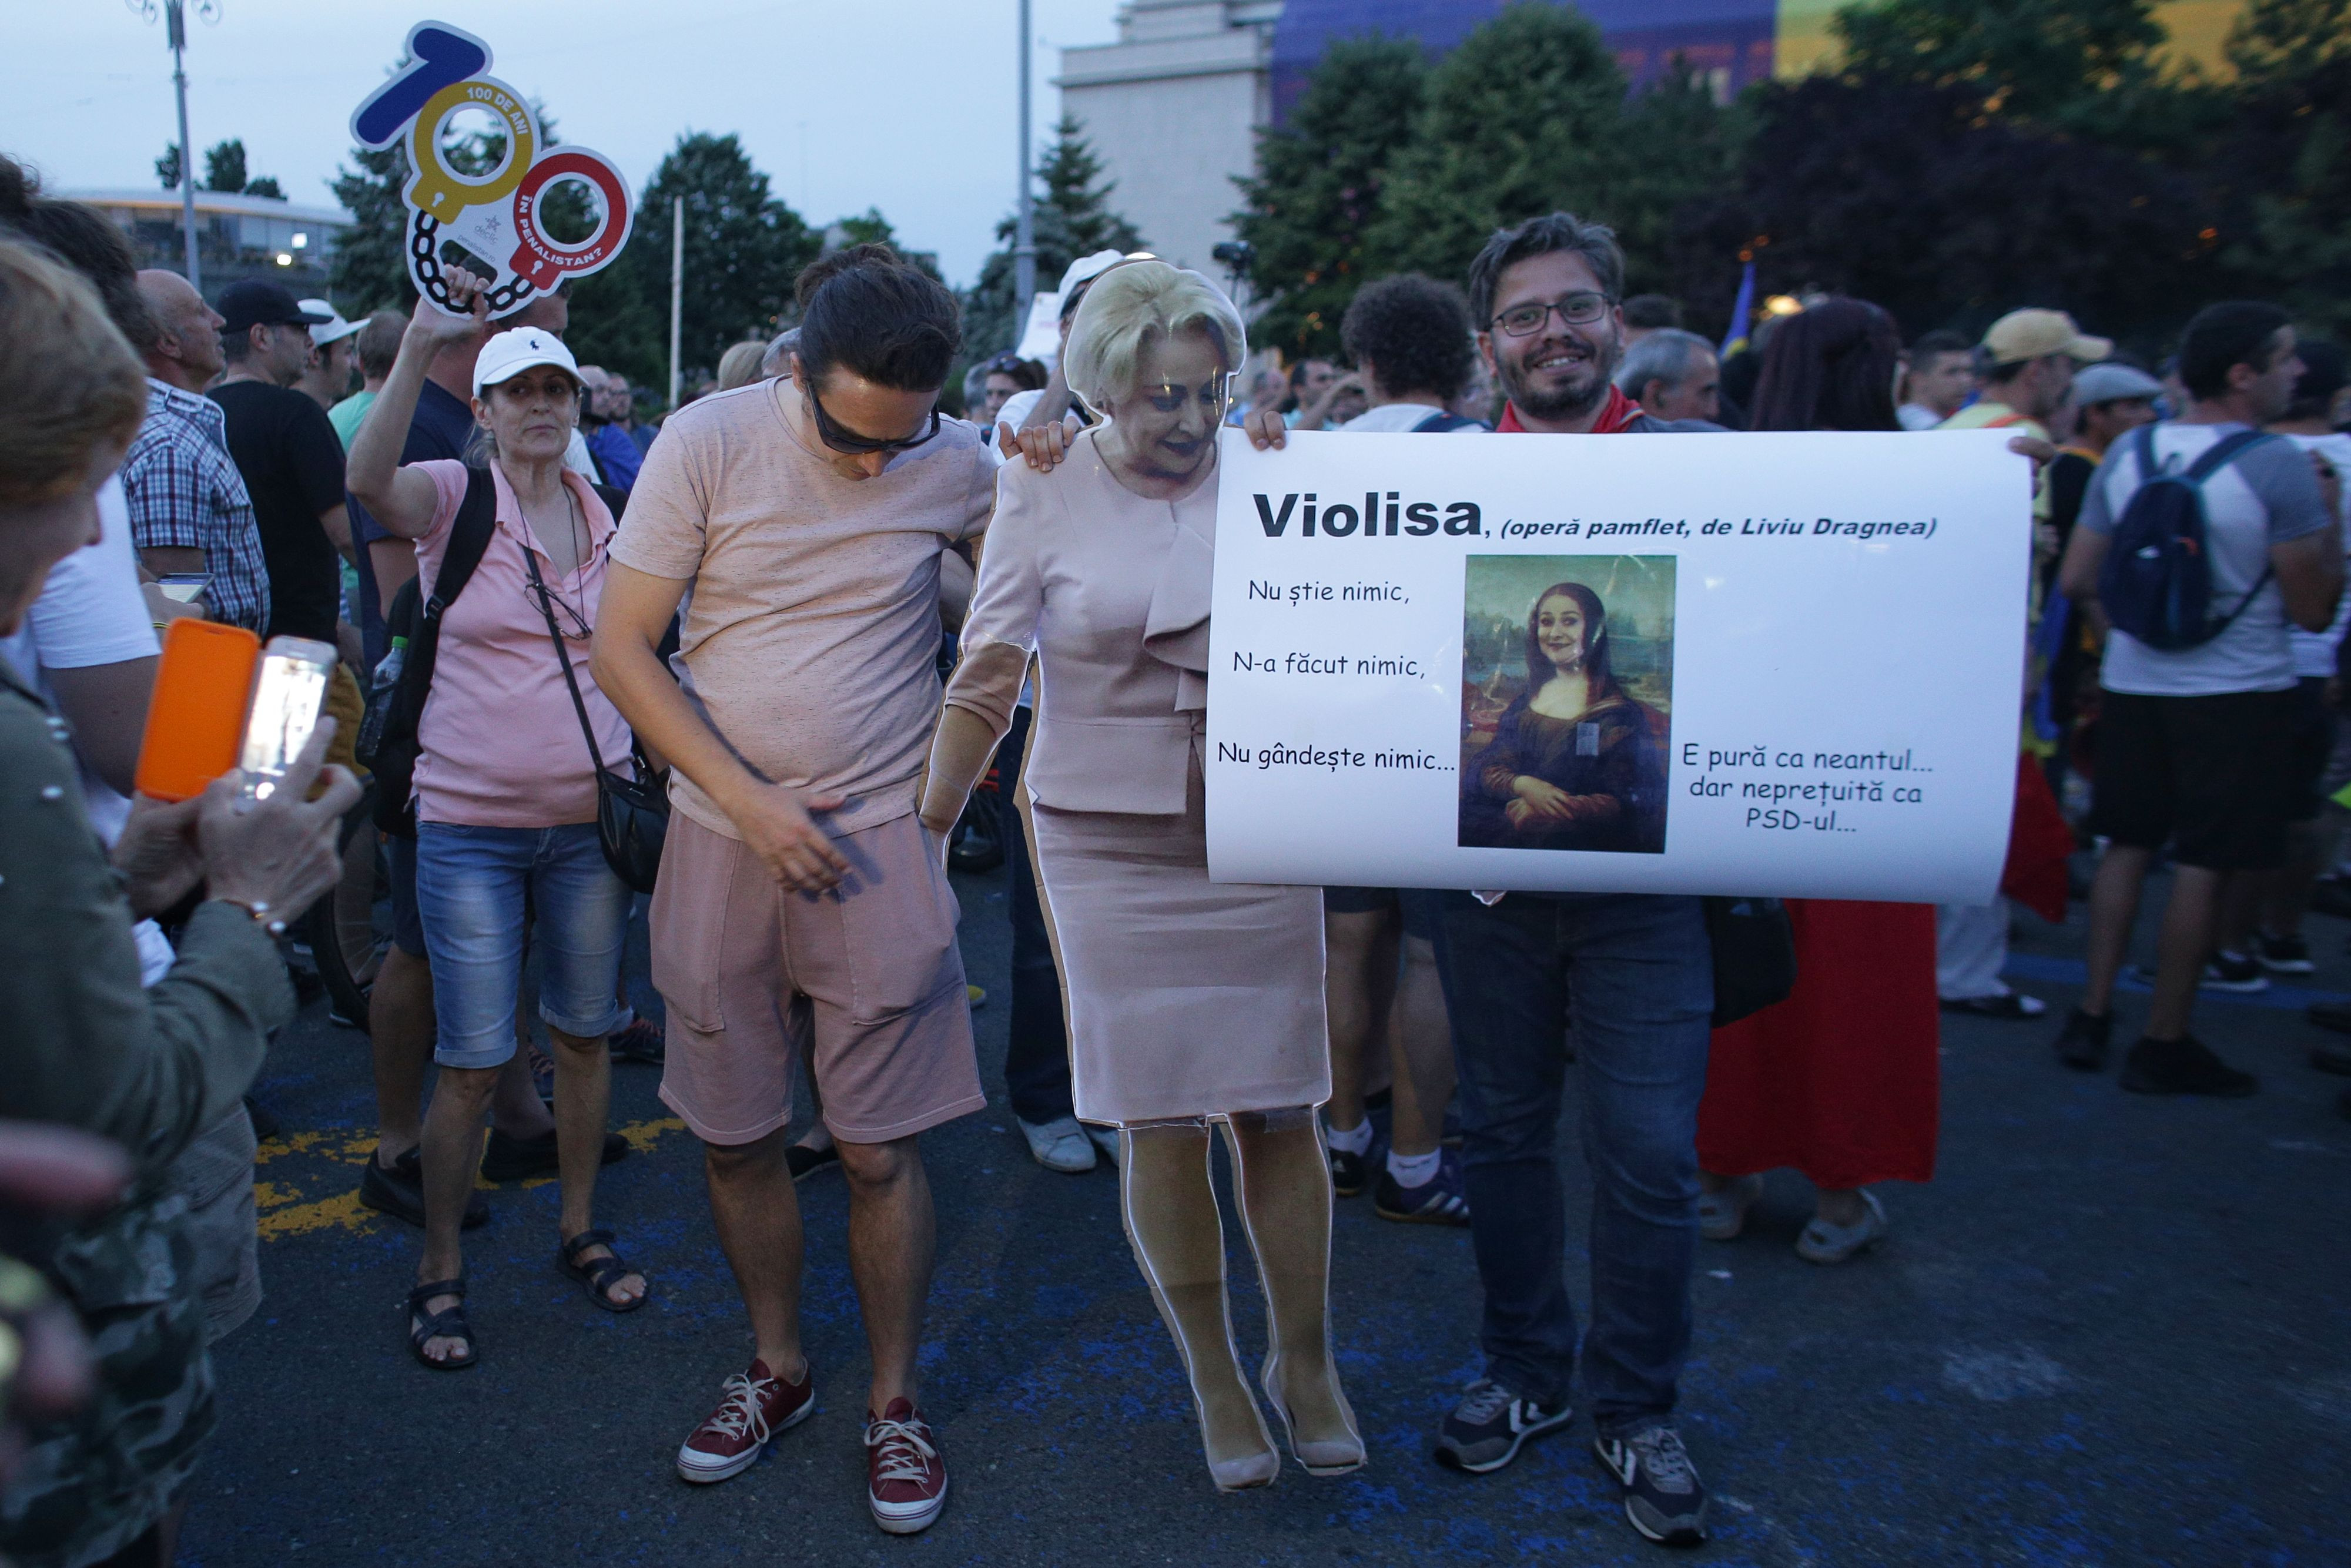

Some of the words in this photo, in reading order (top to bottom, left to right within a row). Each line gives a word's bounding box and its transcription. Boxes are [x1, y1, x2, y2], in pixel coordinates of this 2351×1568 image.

[467, 86, 493, 100] 100
[494, 92, 515, 112] DE
[509, 111, 528, 135] ANI
[520, 219, 602, 266] PENALISTAN?
[1252, 491, 1490, 539] Violisa,
[1501, 519, 1580, 540] (operă
[1586, 518, 1690, 539] pamflet,
[1701, 518, 1732, 535] de
[1741, 518, 1804, 535] Liviu
[1813, 518, 1937, 540] Dragnea)
[1249, 579, 1281, 601] Nu
[1289, 581, 1334, 607] știe
[1343, 581, 1409, 604] nimic,
[1234, 651, 1276, 672] N-a
[1285, 652, 1348, 674] făcut
[1357, 655, 1425, 679] nimic,
[1218, 742, 1250, 763] Nu
[1258, 742, 1366, 773] gândește
[1375, 748, 1455, 770] nimic...
[1683, 743, 1699, 766] E
[1709, 745, 1766, 772] pură
[1776, 752, 1804, 768] ca
[1814, 749, 1933, 772] neantul...
[1690, 776, 1733, 797] dar
[1743, 782, 1883, 808] neprețuită
[1893, 788, 1921, 803] ca
[1746, 808, 1857, 833] PSD-ul...
